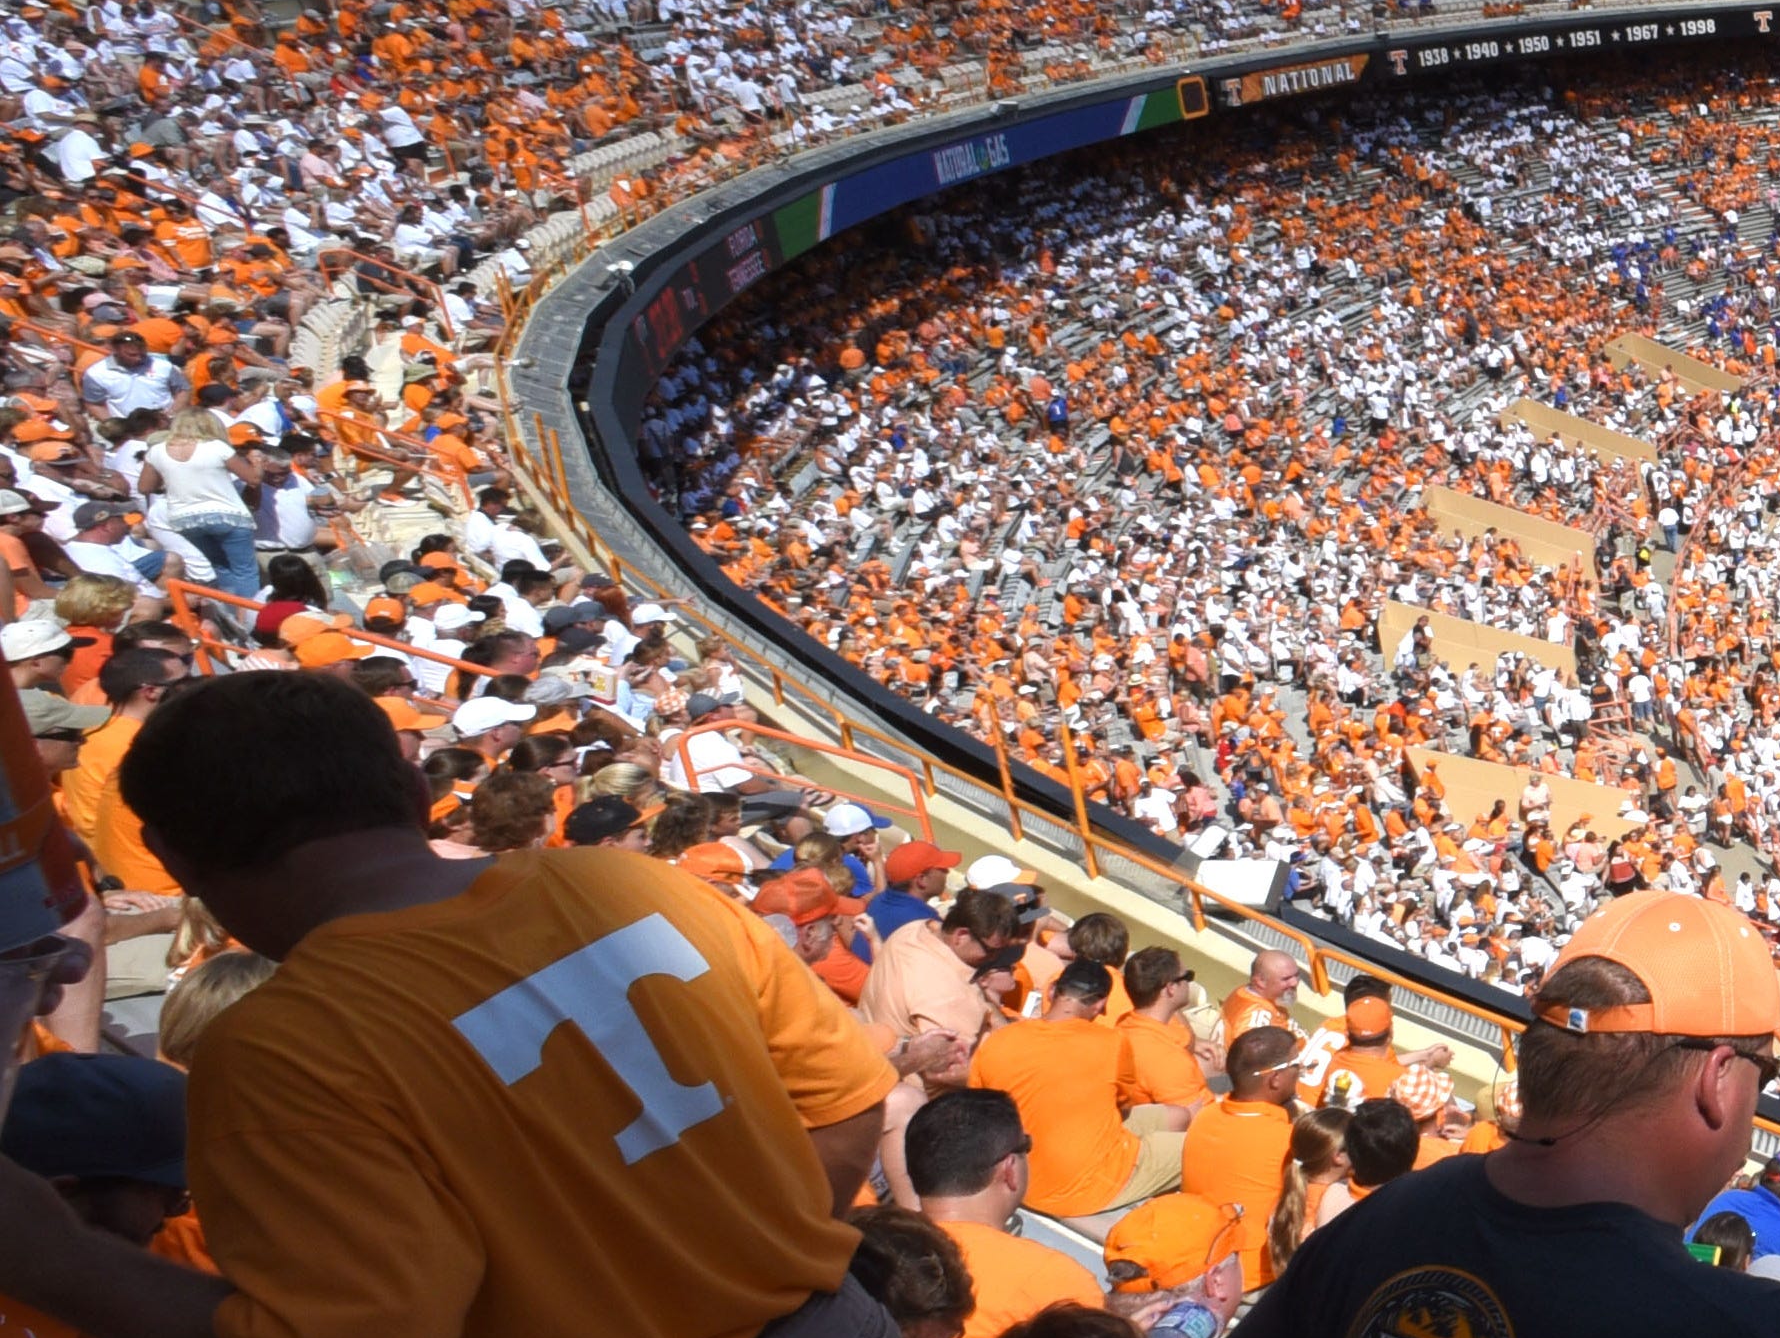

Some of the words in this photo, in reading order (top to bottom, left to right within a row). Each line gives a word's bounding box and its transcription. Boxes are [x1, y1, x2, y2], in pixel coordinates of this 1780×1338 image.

[1418, 46, 1449, 68] 1938
[1465, 40, 1499, 61] 1940
[1518, 34, 1549, 54] 1950
[1569, 28, 1602, 48] 1951
[1626, 23, 1659, 42] 1967
[1680, 18, 1716, 36] 1998
[1263, 62, 1355, 96] NATIONAL
[453, 912, 710, 1166] T
